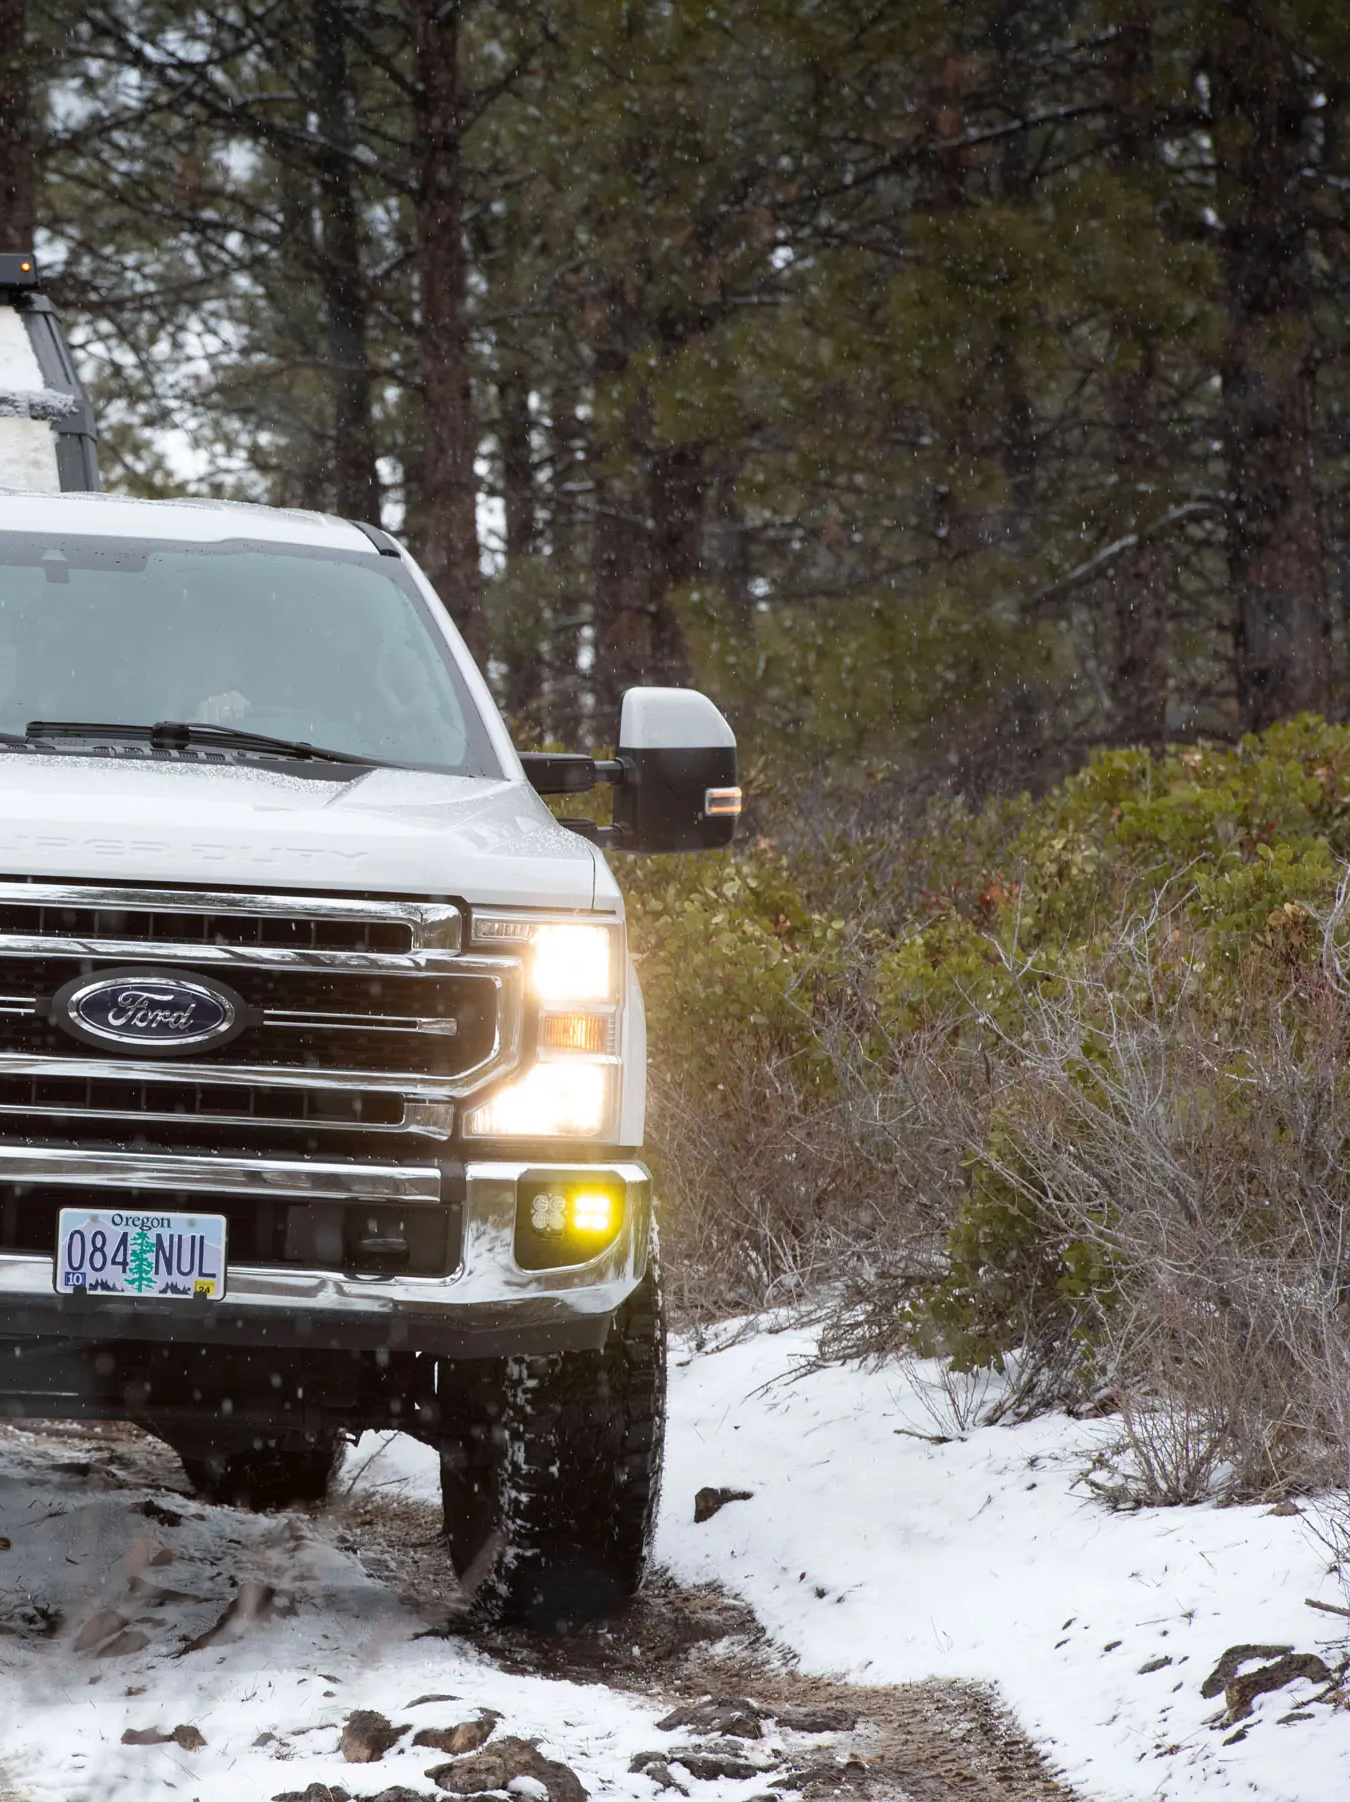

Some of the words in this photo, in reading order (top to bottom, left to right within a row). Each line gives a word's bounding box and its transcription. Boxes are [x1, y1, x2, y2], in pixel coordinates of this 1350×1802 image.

[190, 843, 369, 868] DUTY
[107, 990, 197, 1031] Ford
[111, 1213, 172, 1231] Oregon
[67, 1229, 129, 1274] 084
[154, 1233, 217, 1279] NUL
[67, 1273, 83, 1286] 10
